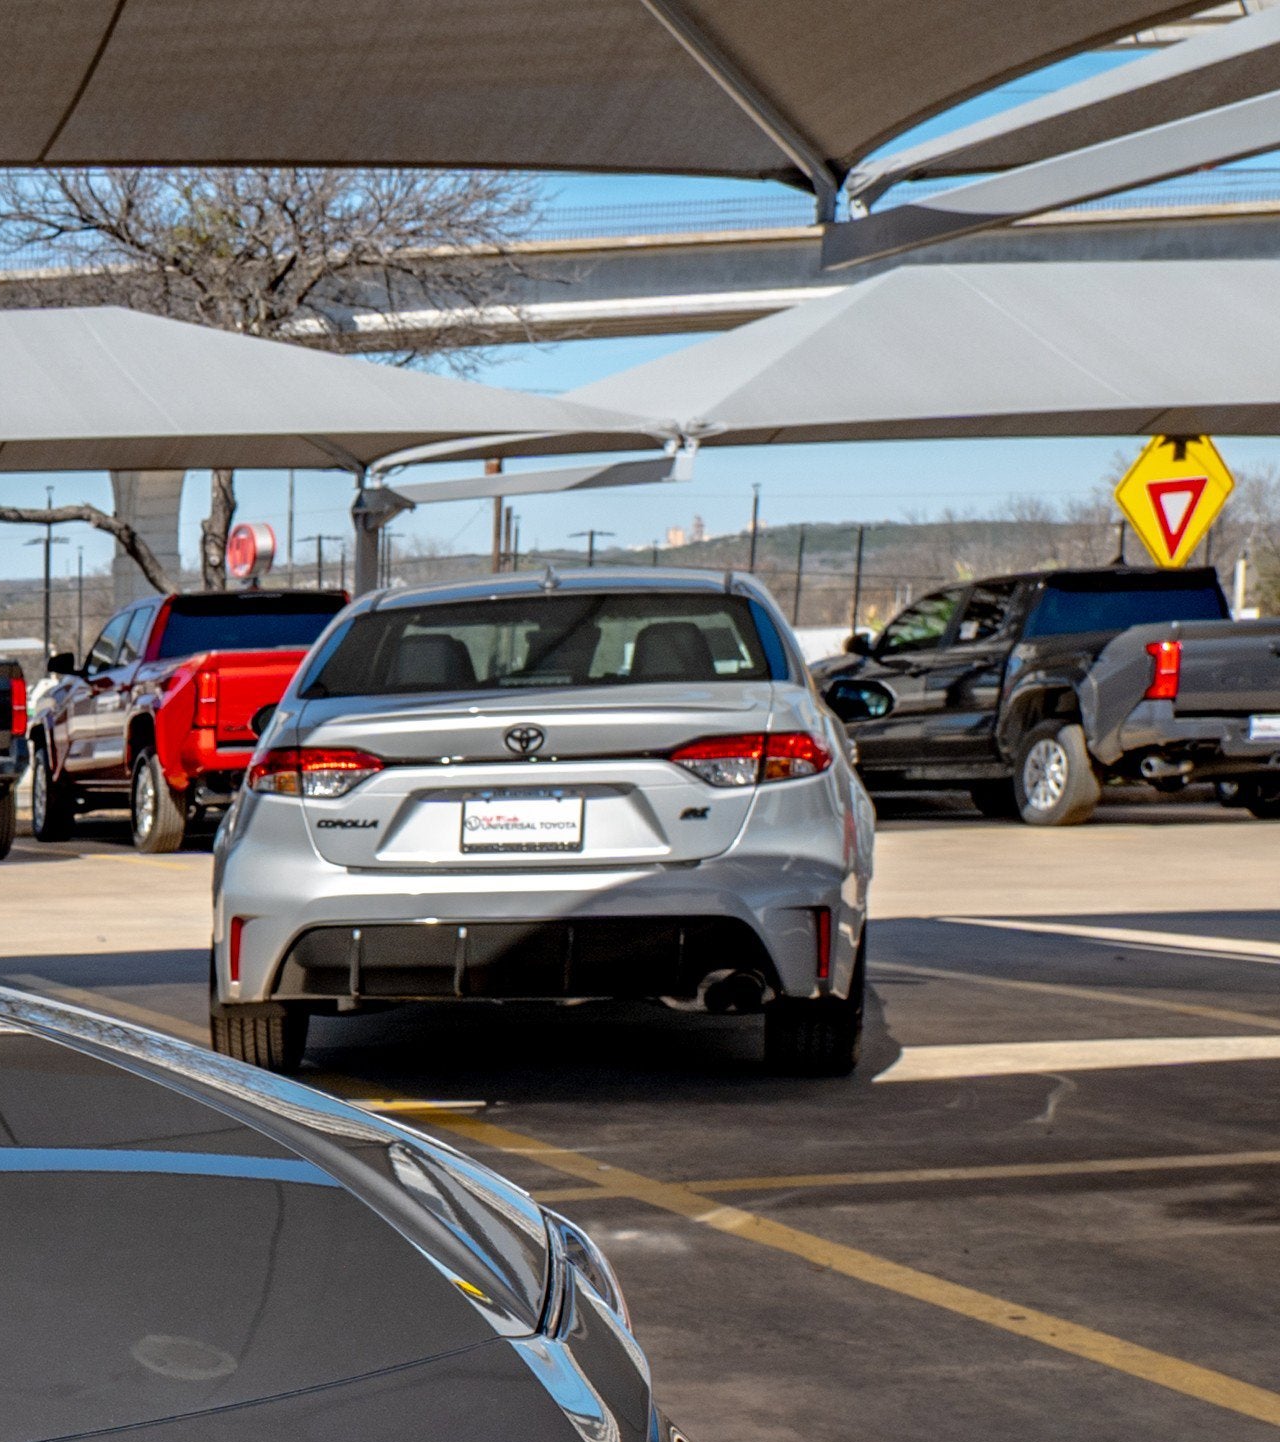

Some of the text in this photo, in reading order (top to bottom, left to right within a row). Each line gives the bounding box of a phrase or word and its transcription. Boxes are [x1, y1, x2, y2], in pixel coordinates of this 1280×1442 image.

[316, 818, 379, 829] COROLLA
[481, 820, 577, 831] UNIVERSAL TOYOTA
